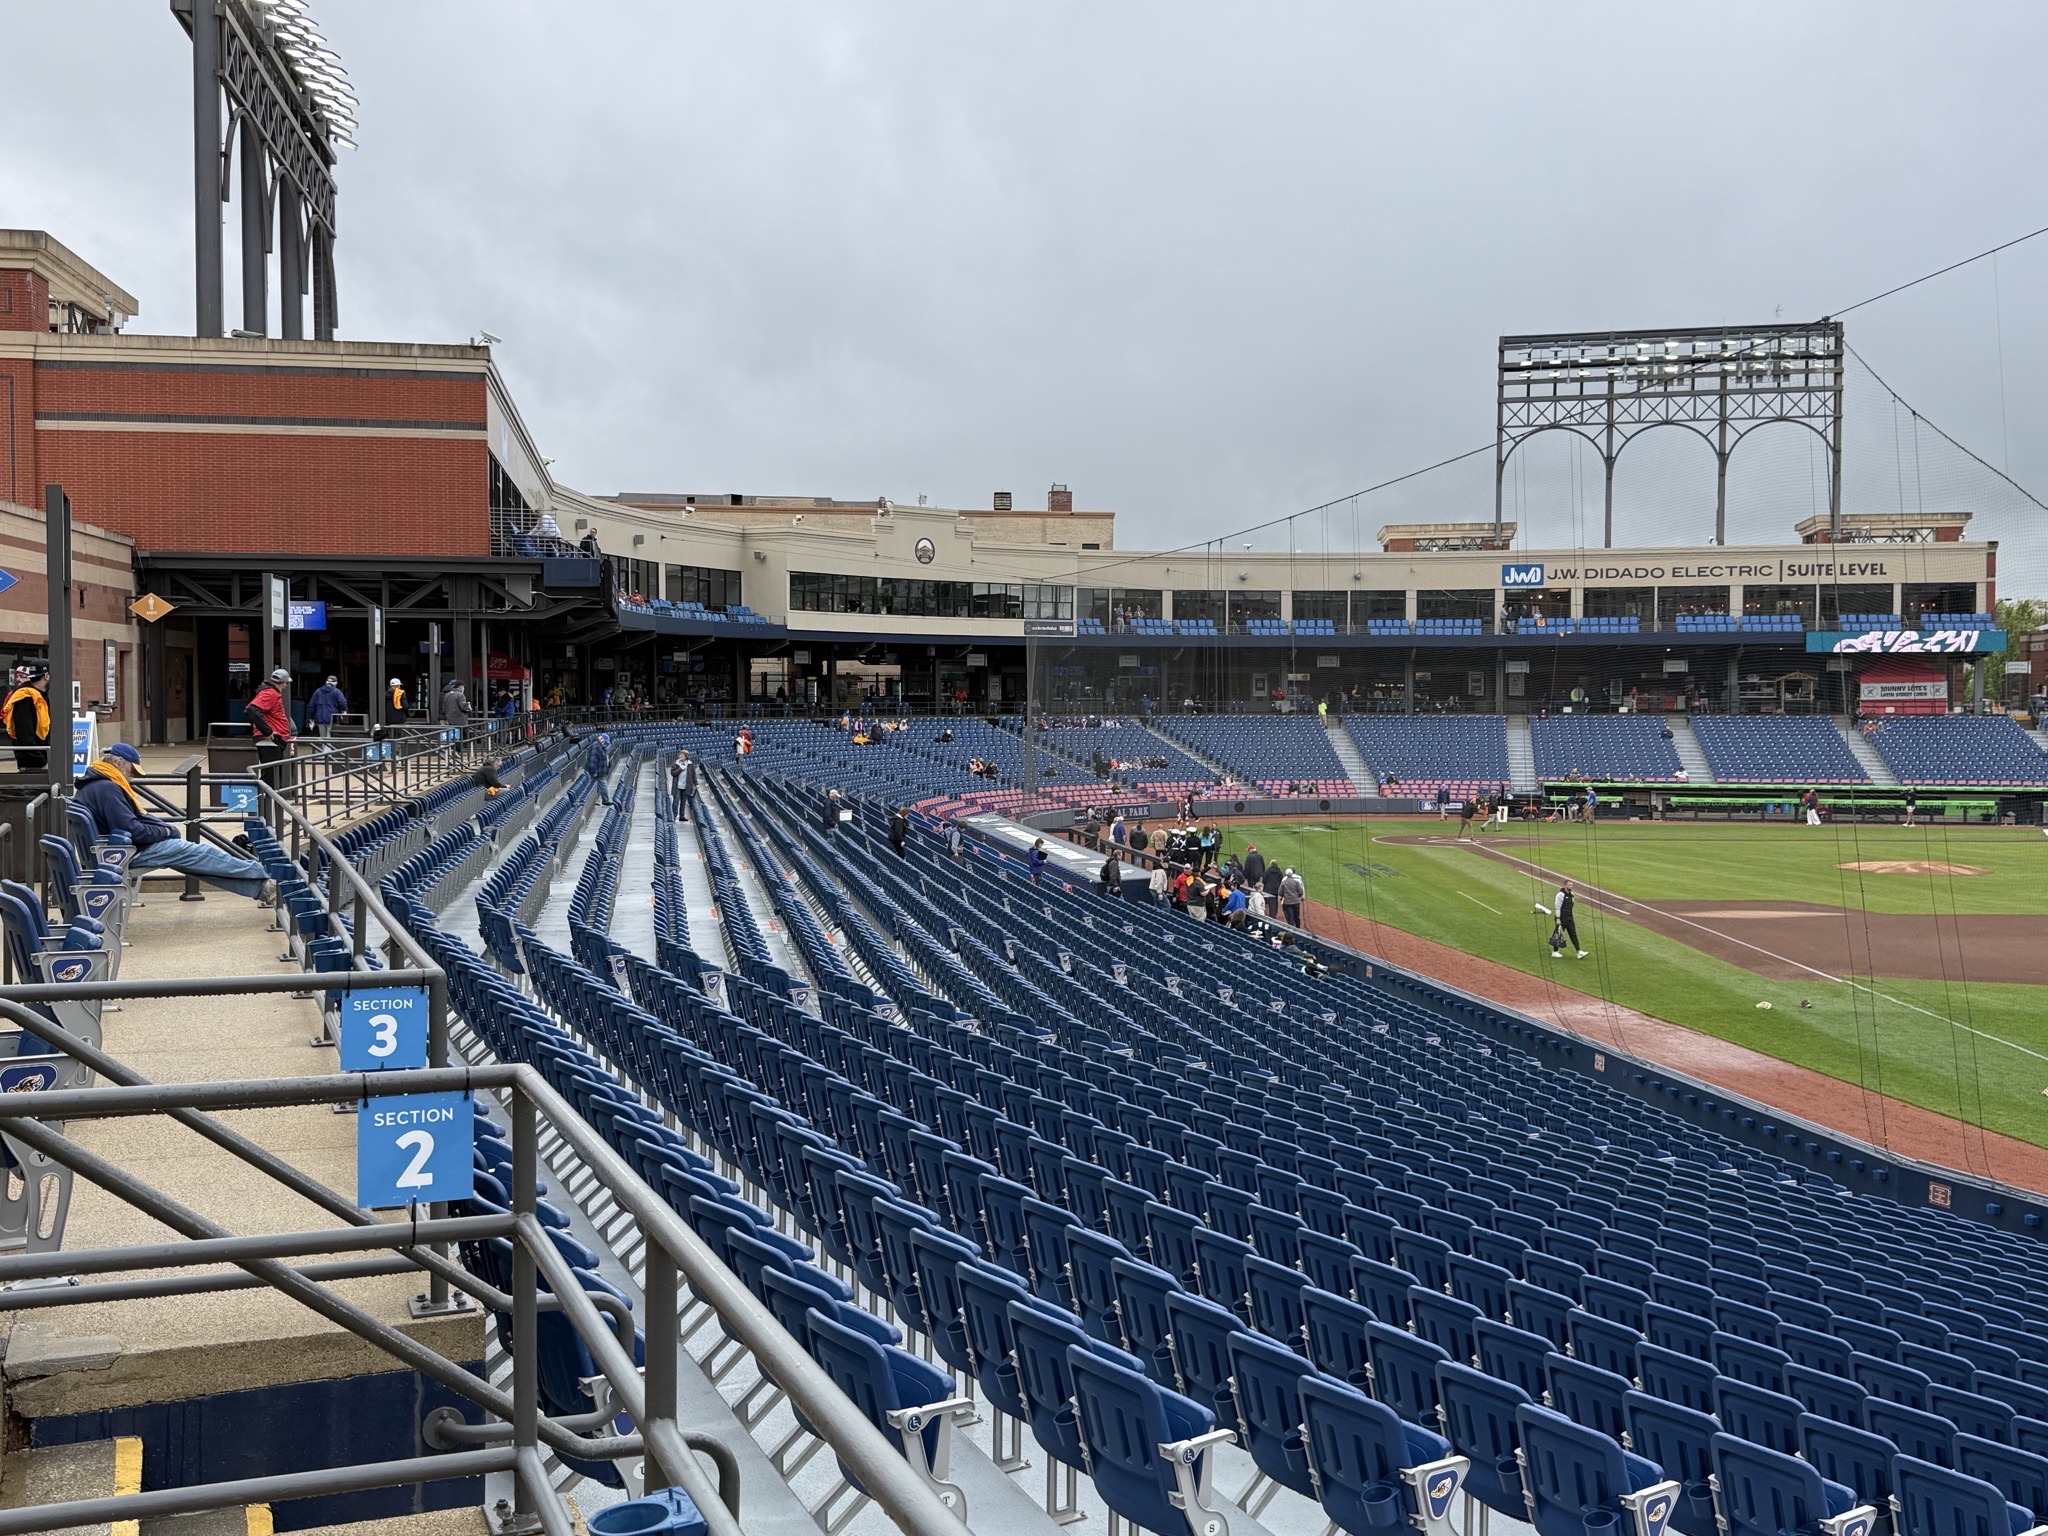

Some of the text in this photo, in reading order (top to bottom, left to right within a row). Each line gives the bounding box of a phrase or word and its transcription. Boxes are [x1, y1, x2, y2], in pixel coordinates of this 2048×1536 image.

[1547, 563, 1887, 580] J.W. DIDADO ELECTRIC SUITE LEVEL
[366, 749, 373, 757] 4
[237, 793, 247, 809] 3
[1129, 806, 1149, 816] PARK
[353, 999, 413, 1011] SECTION
[367, 1014, 398, 1057] 3
[374, 1108, 454, 1127] SECTION
[395, 1130, 435, 1188] 2
[1209, 1523, 1215, 1533] S
